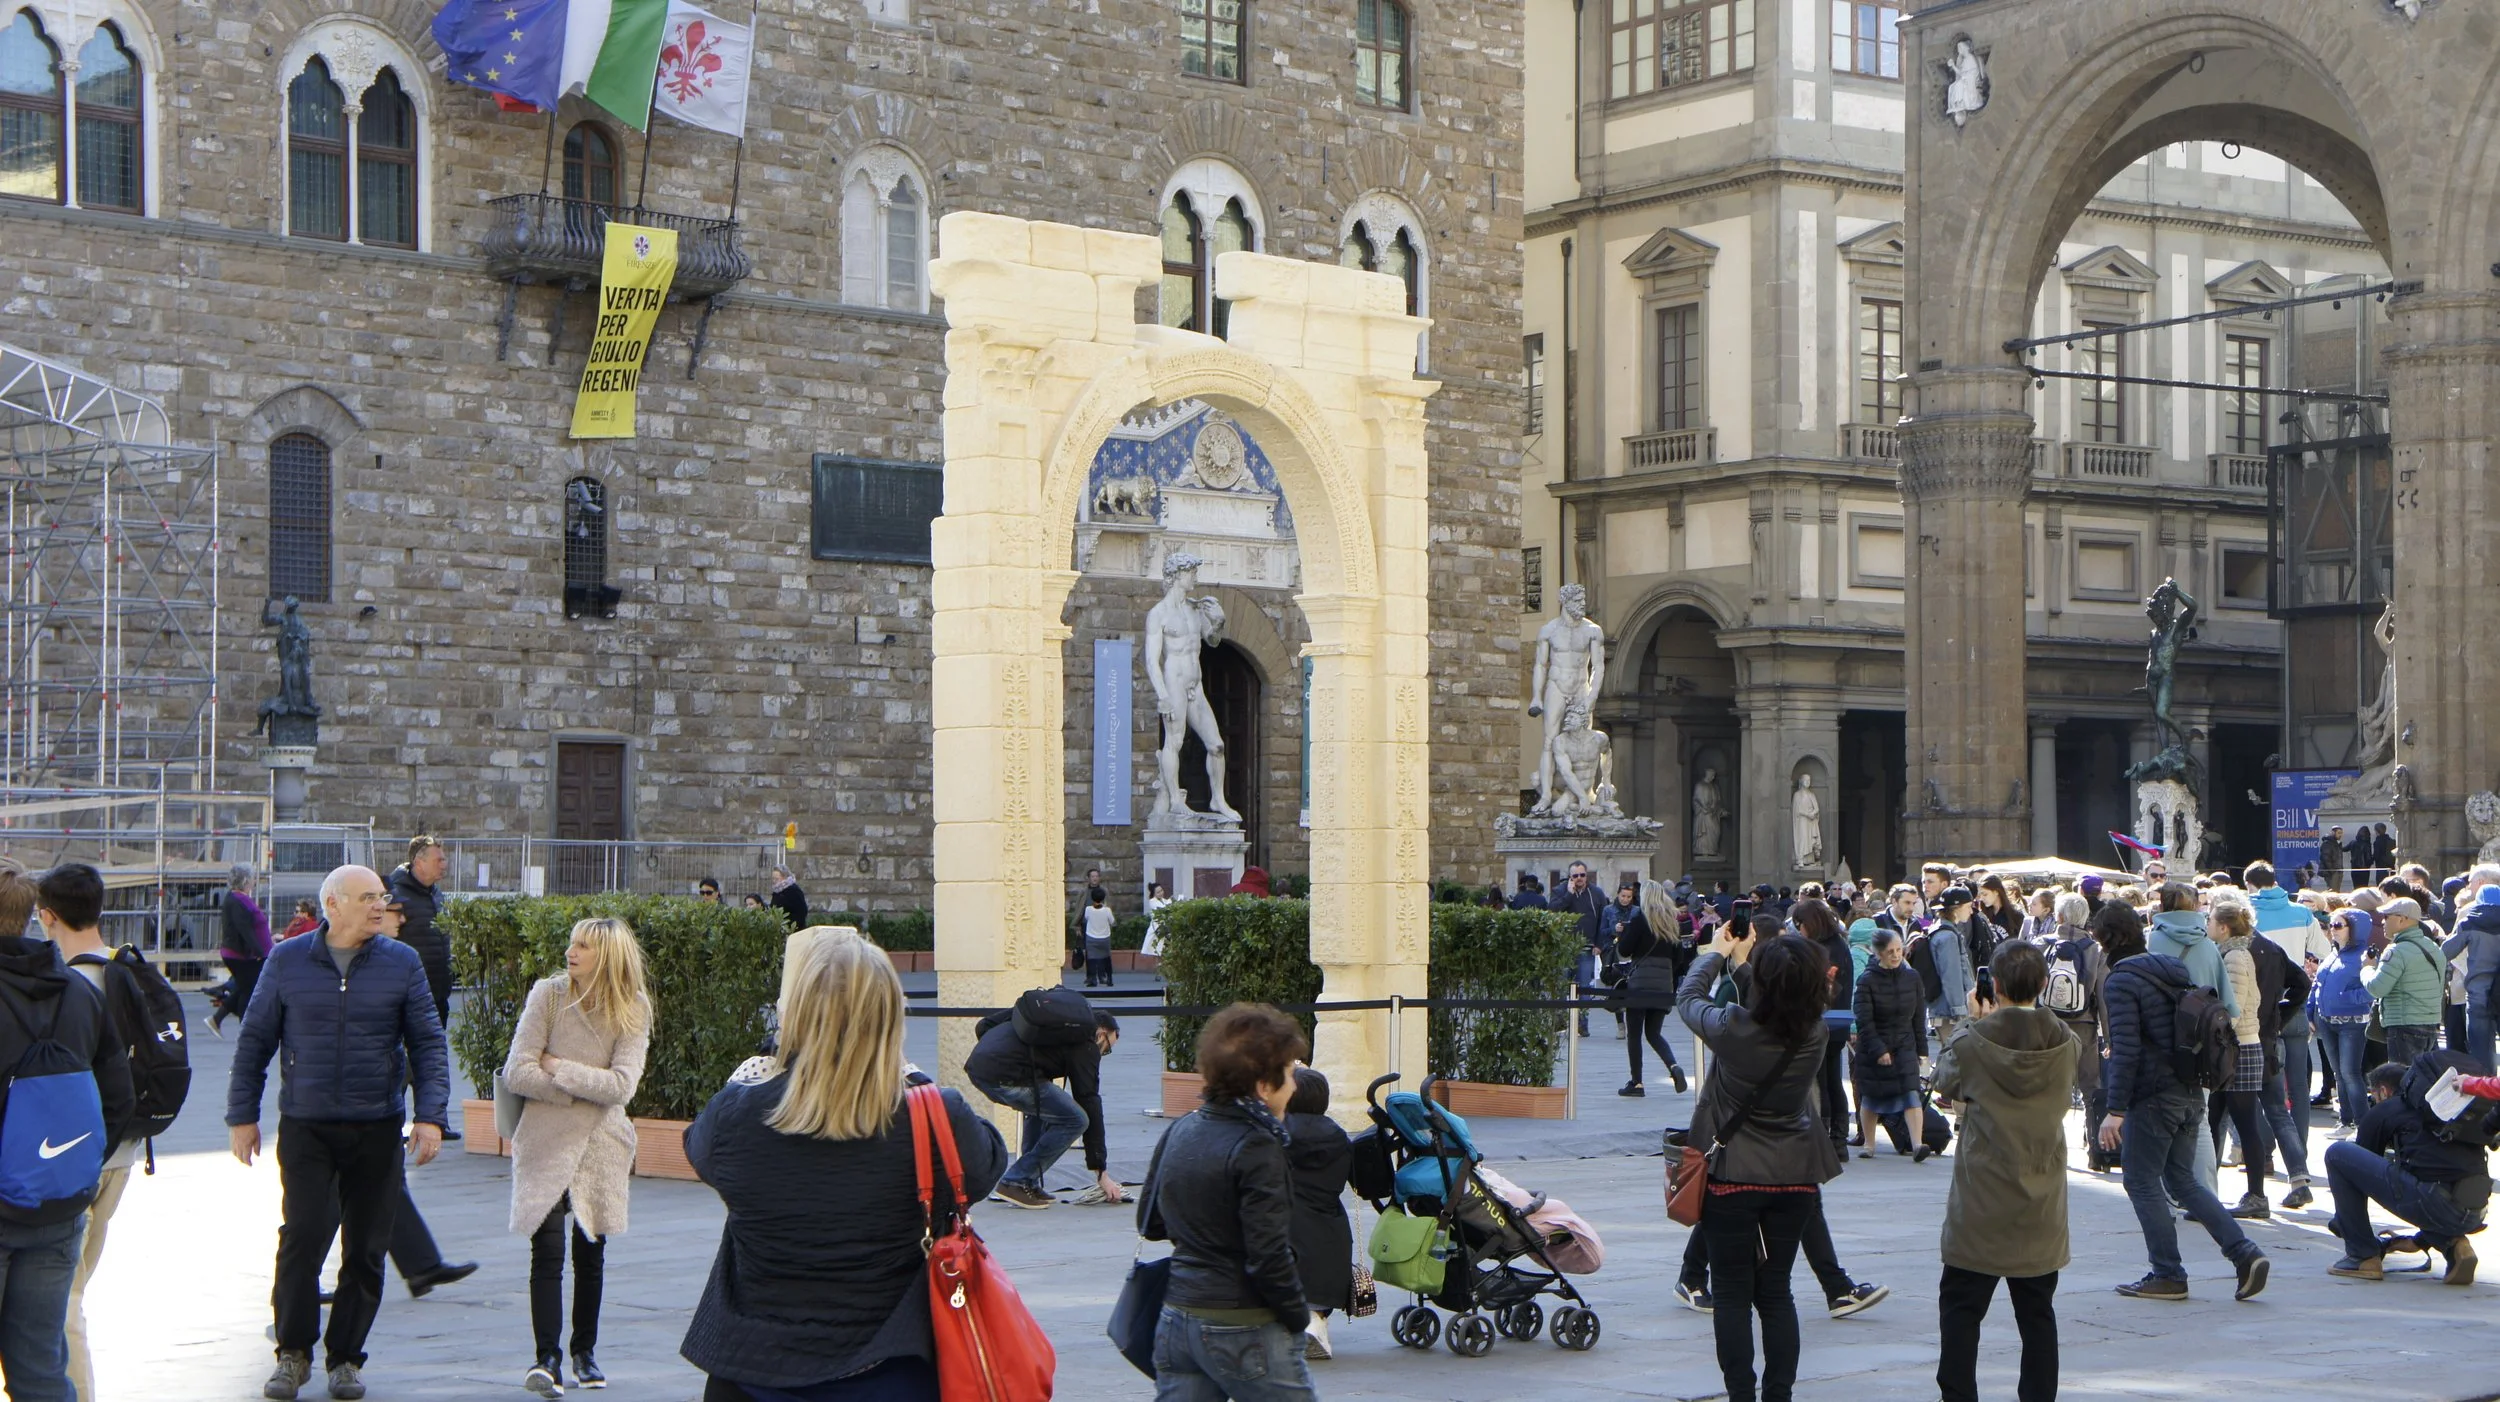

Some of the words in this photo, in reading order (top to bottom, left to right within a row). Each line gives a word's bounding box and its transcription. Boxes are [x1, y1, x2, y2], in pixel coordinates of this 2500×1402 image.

[597, 314, 629, 337] PER
[590, 340, 642, 363] GIULIO
[581, 368, 638, 393] REGENI
[1106, 668, 1118, 710] Vecchio
[1106, 712, 1120, 758] Palazzo
[2276, 808, 2299, 829] Bill
